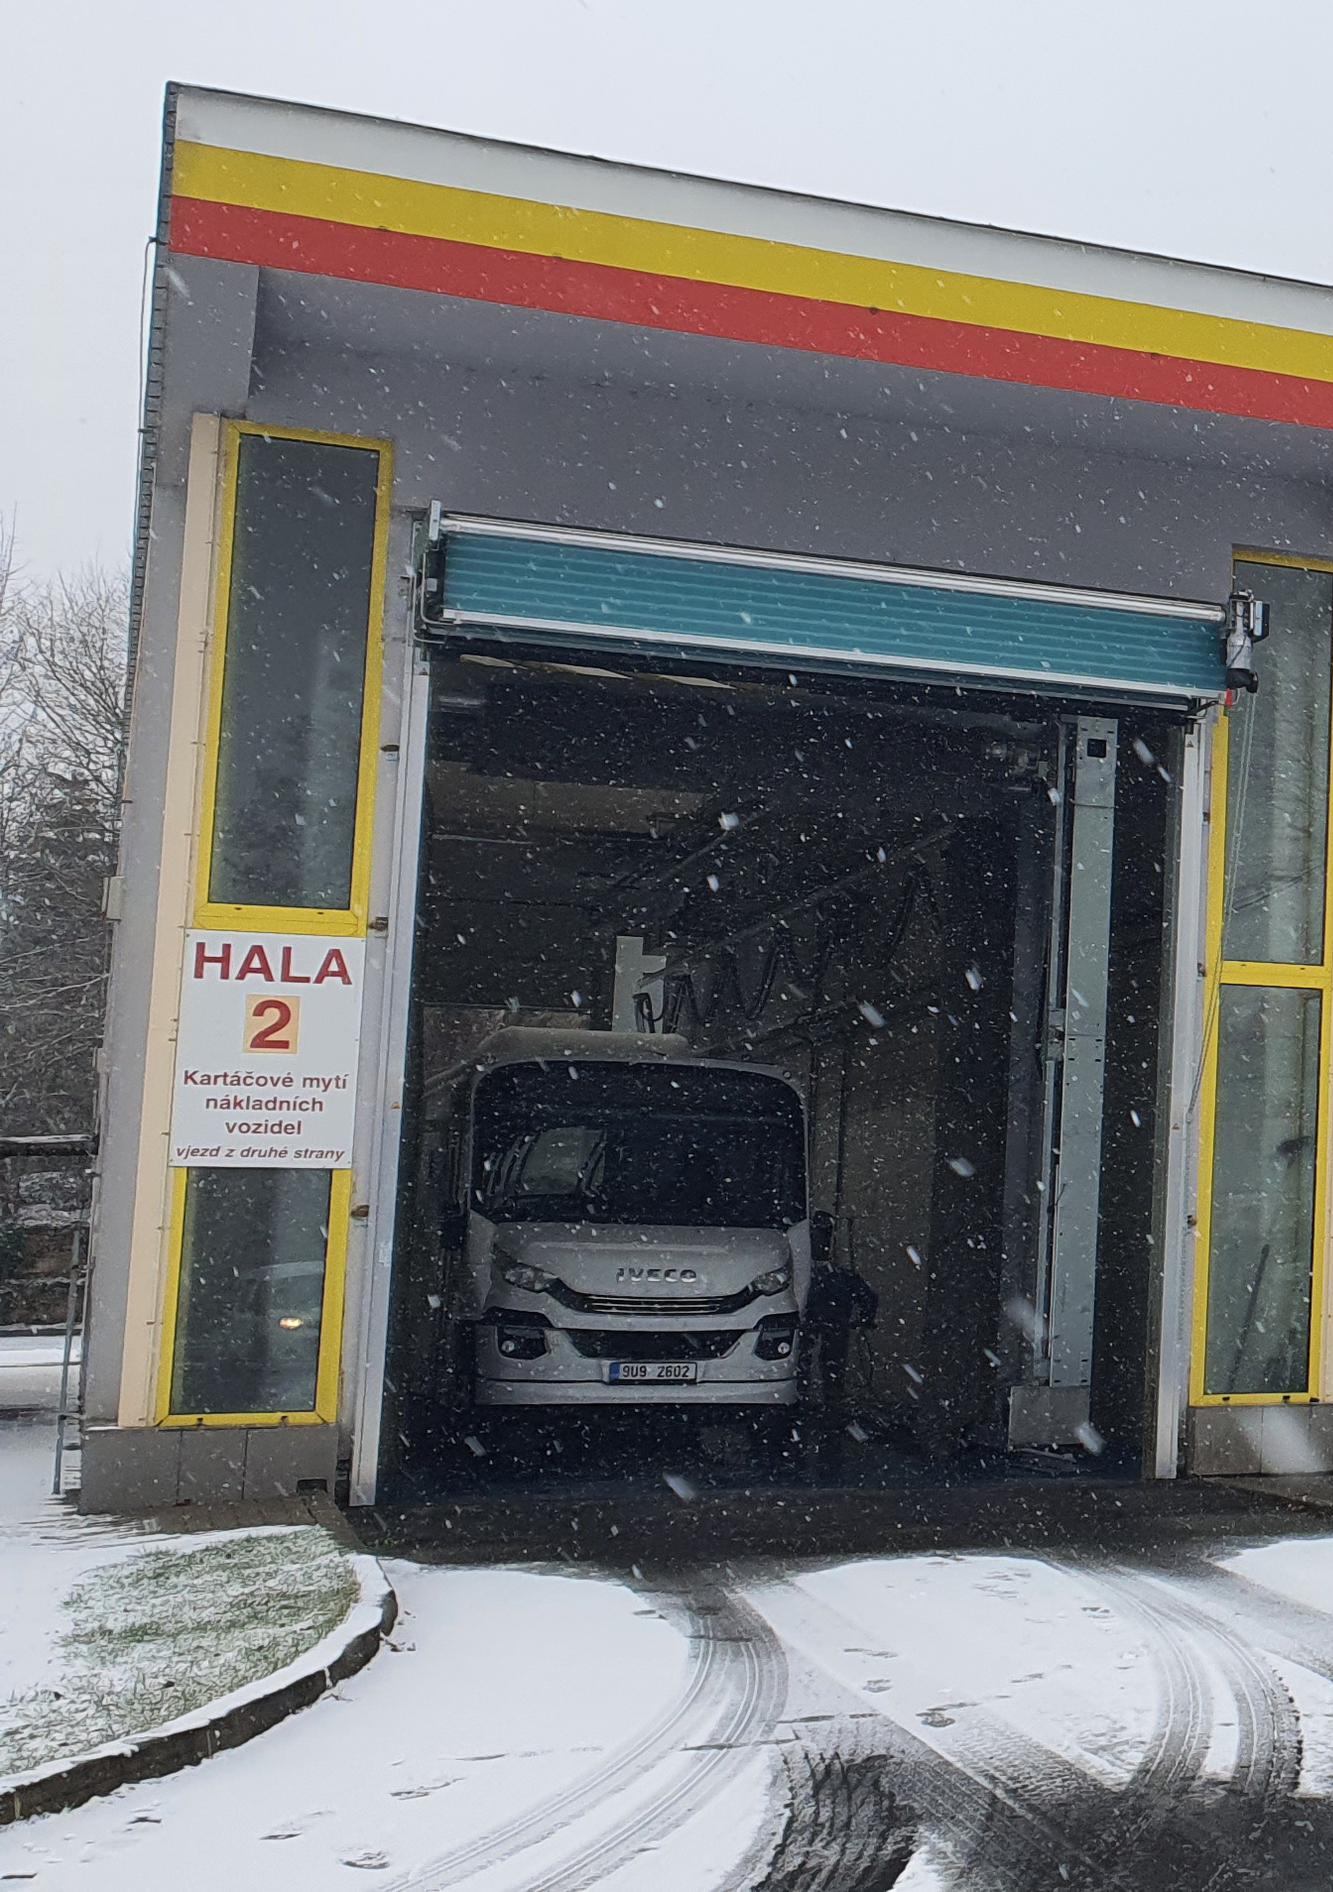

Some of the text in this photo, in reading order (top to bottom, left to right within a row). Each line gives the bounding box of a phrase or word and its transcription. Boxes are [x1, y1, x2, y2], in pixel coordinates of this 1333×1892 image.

[194, 942, 352, 985] HALA
[250, 999, 292, 1049] 2
[183, 1070, 350, 1092] Kartáčové mytí
[205, 1095, 324, 1112] nákladních
[225, 1120, 302, 1135] vozidel
[176, 1145, 346, 1161] vjezd z druhé strany
[616, 1267, 697, 1283] IVECO
